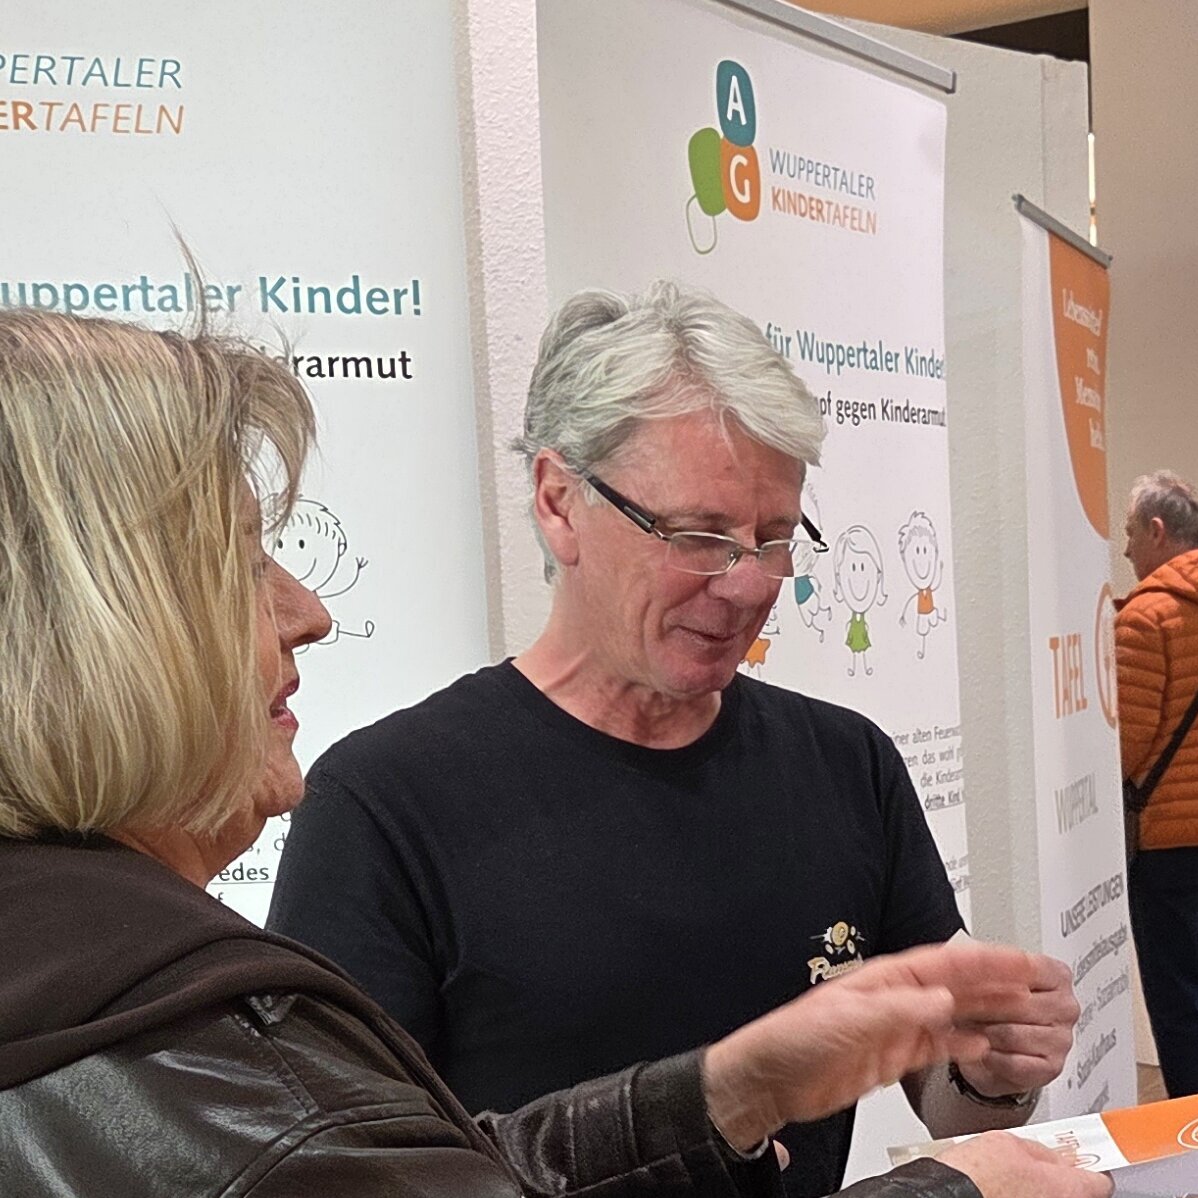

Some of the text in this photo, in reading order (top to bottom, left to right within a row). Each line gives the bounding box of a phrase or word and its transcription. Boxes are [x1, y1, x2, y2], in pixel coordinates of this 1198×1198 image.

[726, 75, 747, 126] A
[729, 154, 751, 204] G
[769, 147, 876, 201] WUPPERTALER
[770, 185, 877, 235] KINDERTAFELN
[259, 274, 421, 316] Kinder!
[796, 329, 900, 376] Wuppertaler
[836, 398, 876, 427] gegen
[1049, 633, 1088, 720] TAFEL
